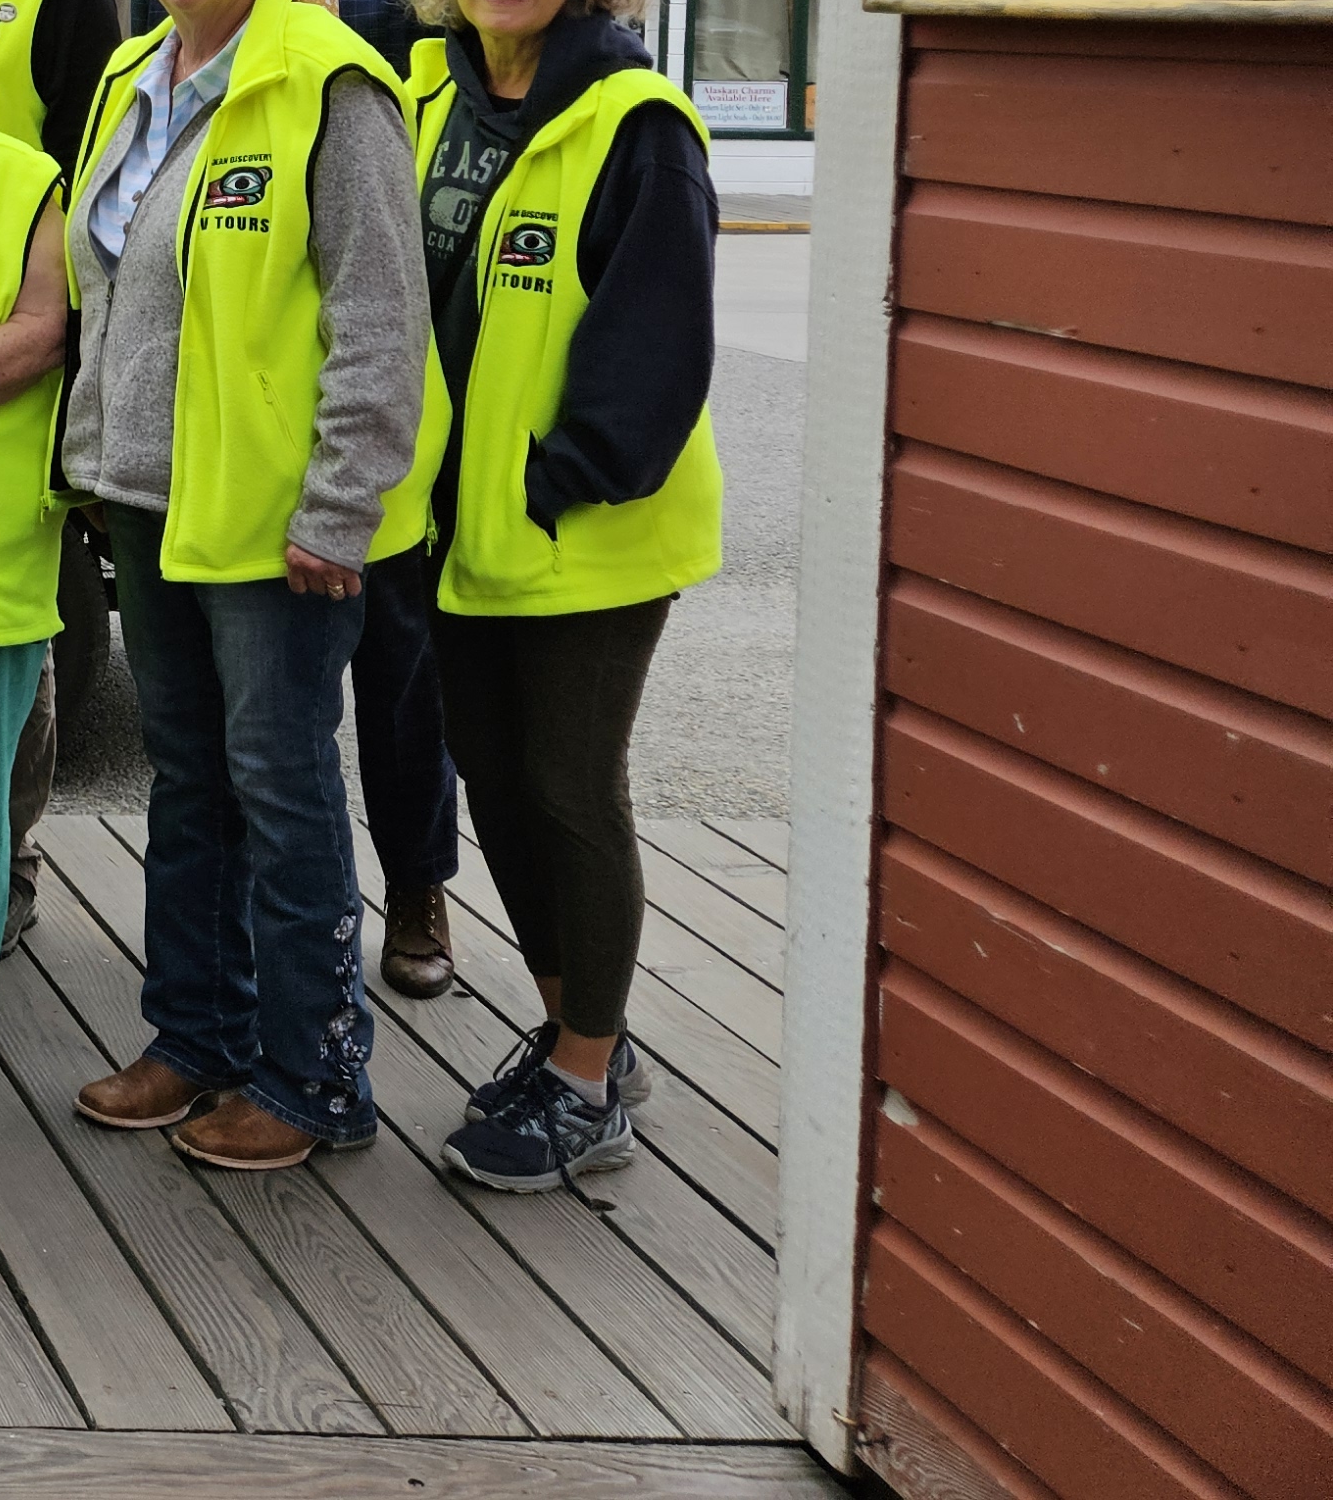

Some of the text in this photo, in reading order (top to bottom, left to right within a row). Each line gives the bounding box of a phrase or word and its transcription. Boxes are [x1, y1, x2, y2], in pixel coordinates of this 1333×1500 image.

[703, 86, 776, 94] Alaskan Charms
[707, 94, 747, 102] Available
[214, 216, 270, 233] TOURS
